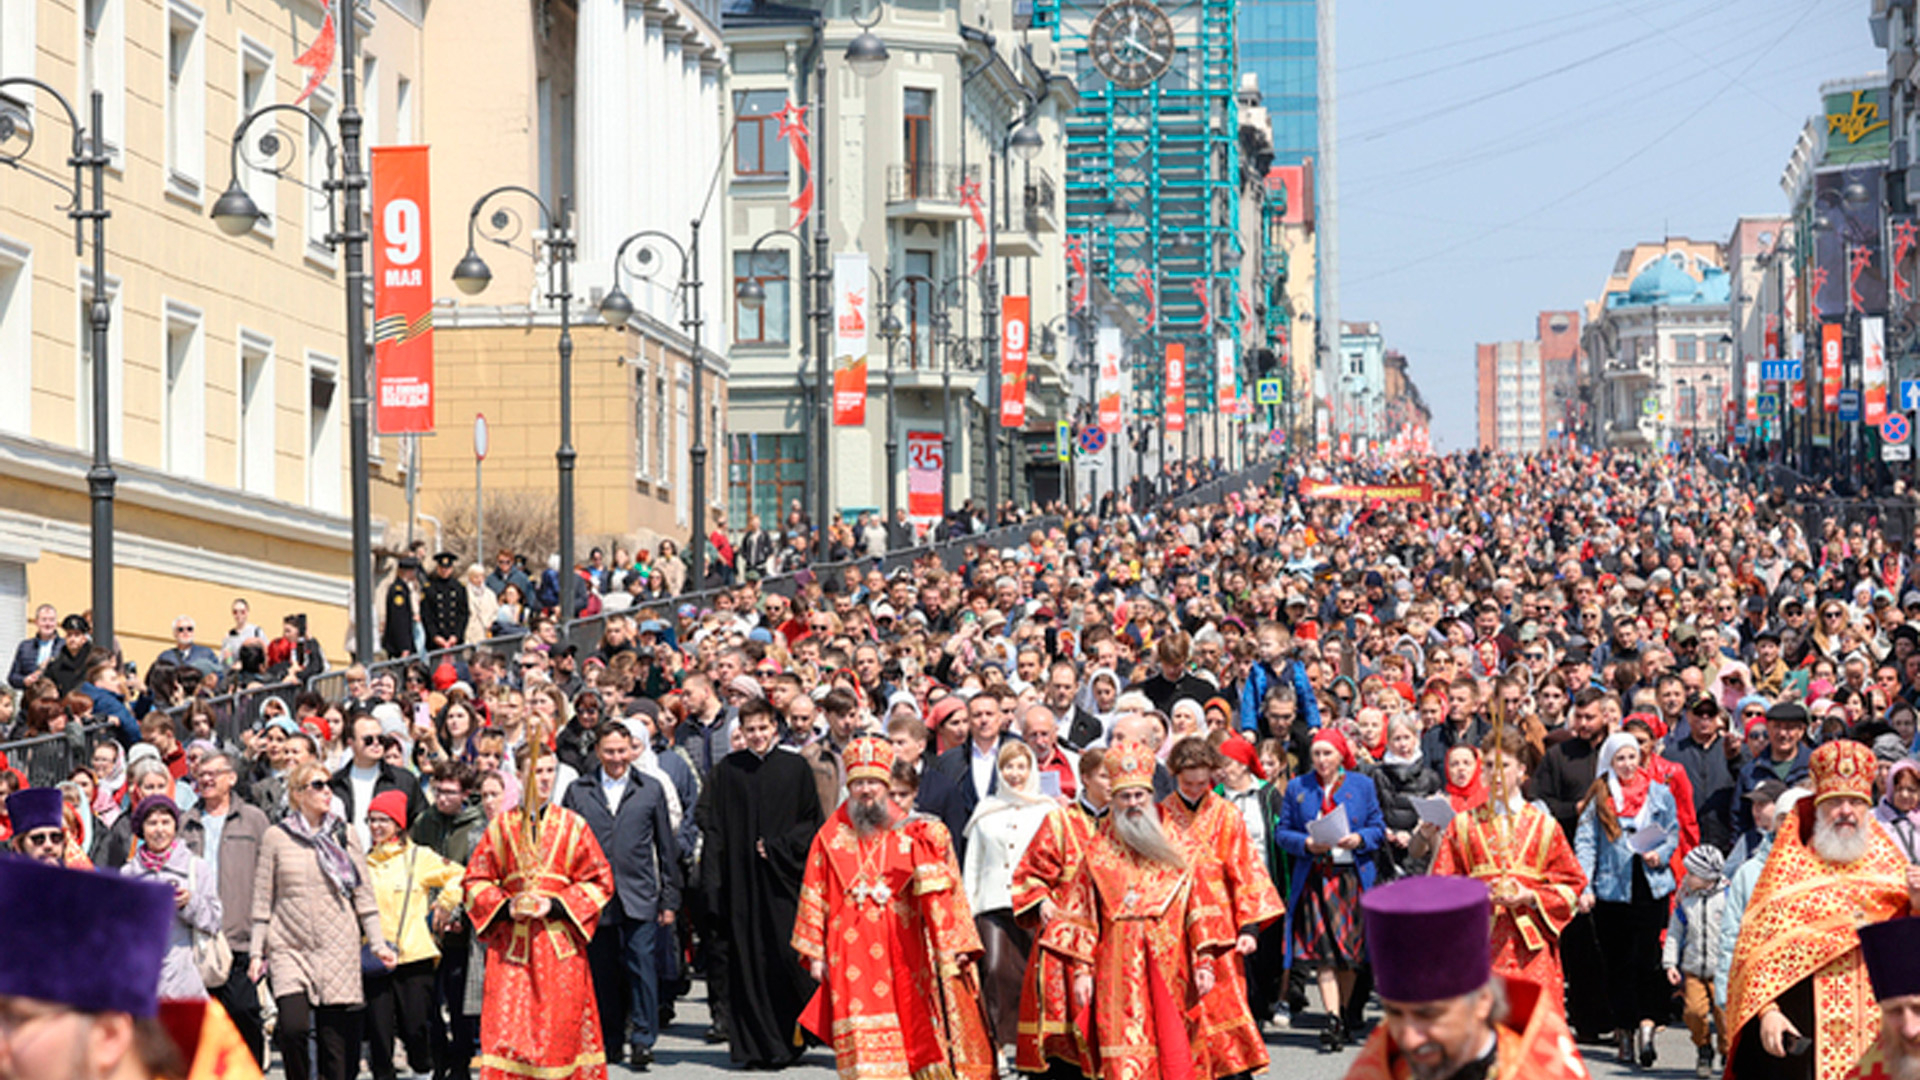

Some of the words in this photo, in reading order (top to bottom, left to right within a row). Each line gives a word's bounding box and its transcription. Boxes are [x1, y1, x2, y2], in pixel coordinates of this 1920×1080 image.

[384, 199, 420, 266] 9
[385, 267, 422, 288] МАЯ
[1006, 319, 1024, 350] 9
[1826, 340, 1839, 361] 9
[1169, 359, 1181, 380] 9
[909, 443, 943, 469] 35
